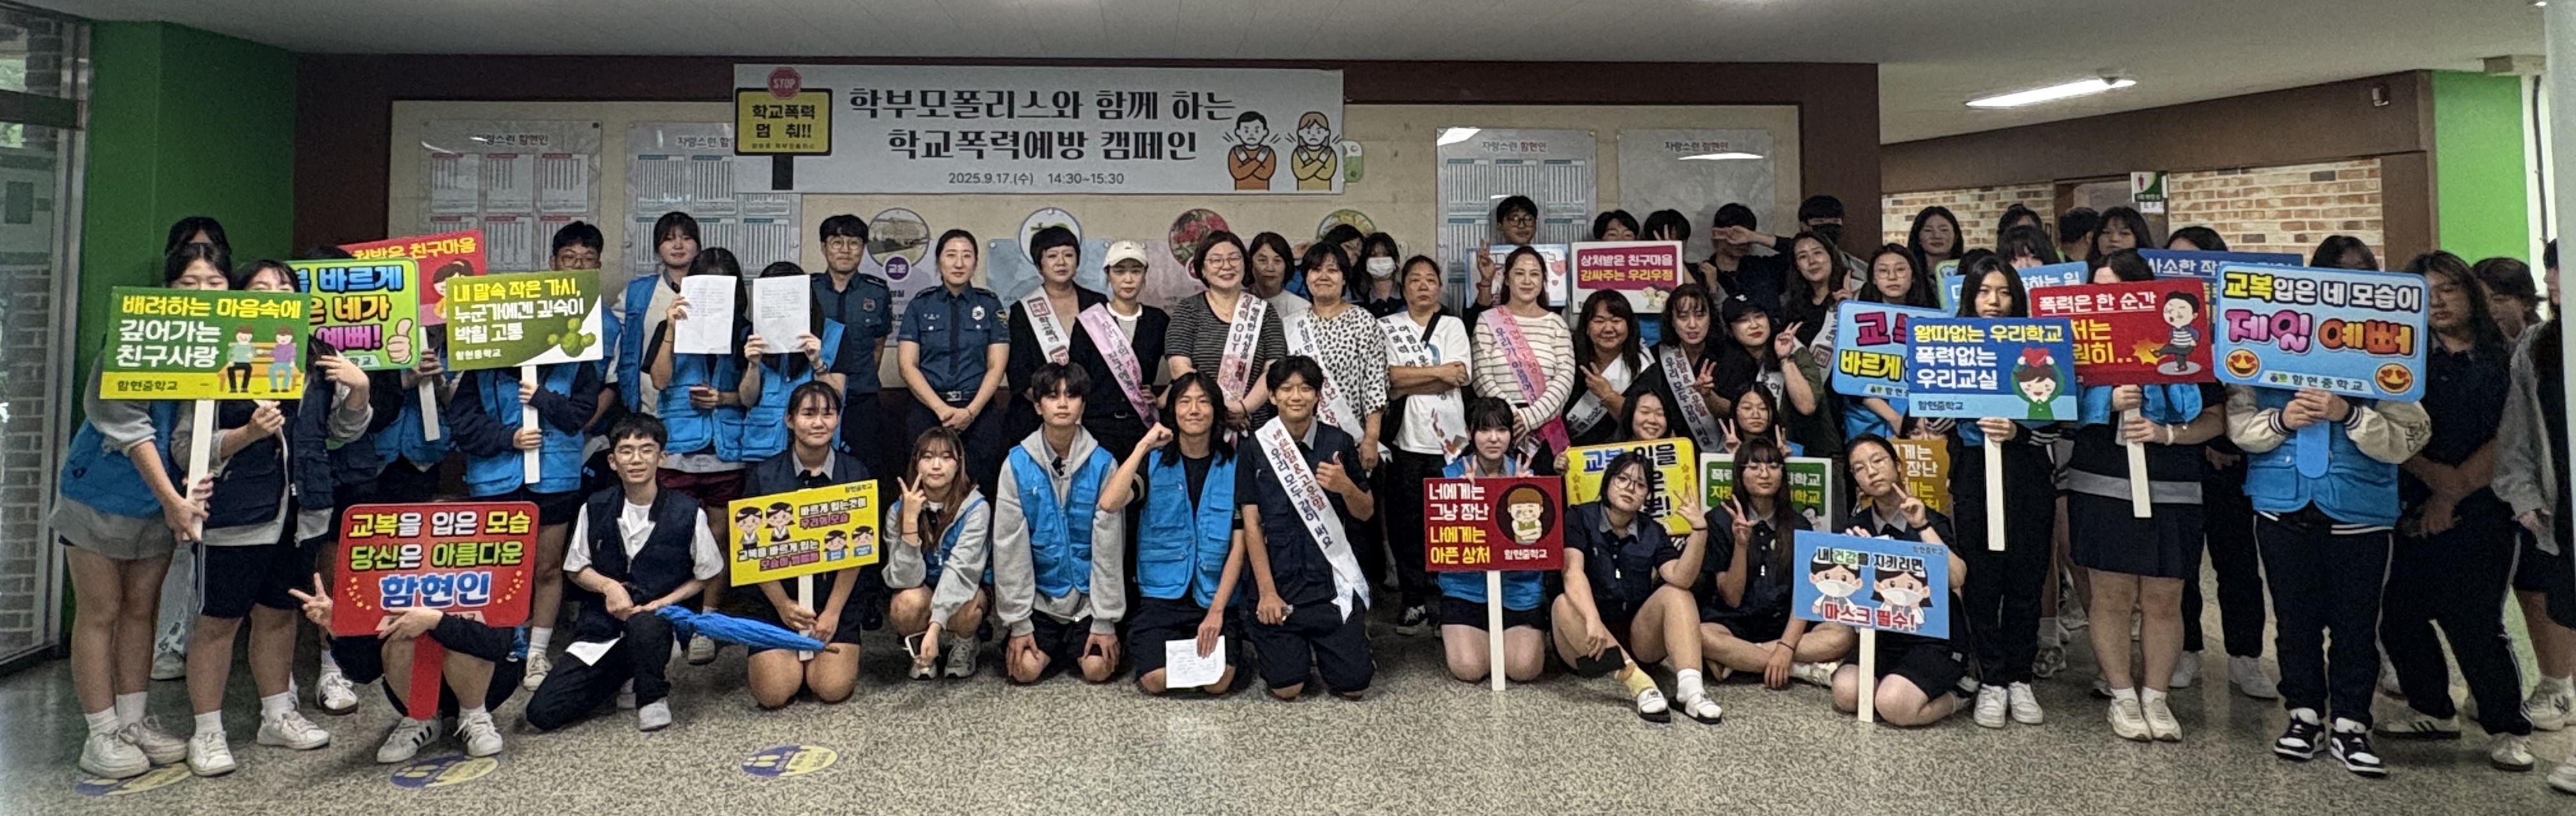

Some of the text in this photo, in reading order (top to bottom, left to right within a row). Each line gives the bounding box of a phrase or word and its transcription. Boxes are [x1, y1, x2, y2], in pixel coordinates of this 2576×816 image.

[773, 78, 796, 89] STOP
[752, 104, 815, 119] 학교폭력
[850, 88, 1236, 121] 학부모폴리스와 함께 하는
[756, 123, 811, 138] 멈 춰!!
[719, 137, 733, 147] 함
[888, 129, 1197, 160] 학교폭력예방 캠페인
[1521, 141, 1547, 152] 함현인
[949, 173, 1034, 185] 2025.9.17.(수)
[1581, 254, 1625, 266] 상처받은
[318, 265, 404, 292] 바르게
[1580, 268, 1673, 282] 감싸주는 우리우정
[454, 278, 581, 302] 내 말속 작은 가시,
[2223, 272, 2317, 305] 교복입은
[2320, 281, 2347, 307] 네
[2350, 282, 2421, 313] 모습이
[122, 295, 301, 319] 배려하는 마음속에
[332, 295, 392, 321] 네가
[455, 298, 583, 323] 누군가에겐 깊숙이
[2039, 291, 2156, 313] 폭력은 한 순간
[119, 319, 222, 343] 깊어가는
[455, 322, 523, 344] 박힐 고통
[1914, 325, 2064, 344] 왕따없는 우리학교
[2225, 309, 2414, 355] 제일 예뻐
[116, 345, 219, 367] 친구사랑
[1915, 346, 1997, 367] 폭력없는
[2072, 342, 2132, 364] 원히..
[1839, 350, 1903, 381] 바르게
[118, 380, 178, 392] 함현중학교
[1916, 369, 1998, 390] 우리교실
[2292, 375, 2364, 391] 함현중학교
[1919, 401, 1964, 411] 함현중학교
[1905, 461, 1938, 477] 장난
[1270, 448, 1291, 473] 우리
[1284, 472, 1302, 499] 모두
[1298, 498, 1321, 523] 같이
[1429, 483, 1485, 500] 너에게는
[1430, 504, 1489, 521] 그냥 장난
[348, 510, 531, 537] 교복을 입은 모습
[1430, 527, 1486, 543] 나에게는
[350, 541, 524, 571] 당신은 아름다운
[1430, 546, 1491, 564] 아픈 상처
[1504, 549, 1548, 560] 함현중학교
[379, 571, 492, 610] 함현인
[1823, 603, 1915, 632] 마스크 필수!
